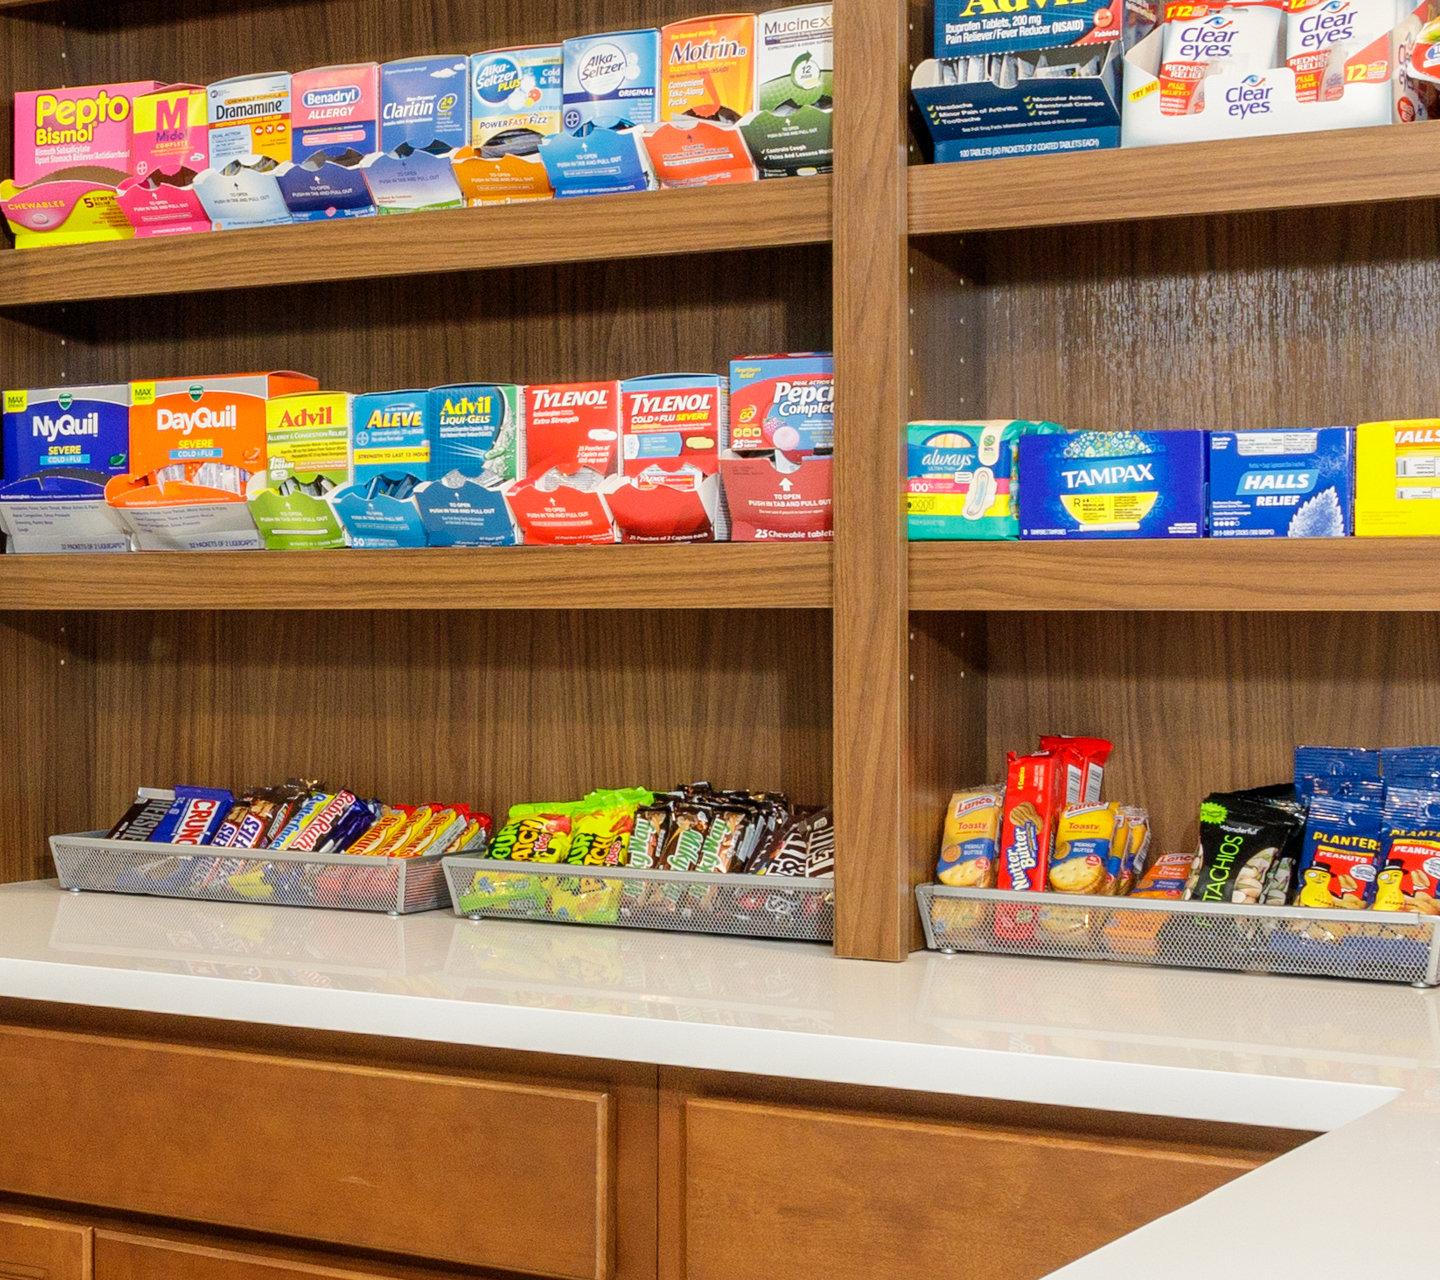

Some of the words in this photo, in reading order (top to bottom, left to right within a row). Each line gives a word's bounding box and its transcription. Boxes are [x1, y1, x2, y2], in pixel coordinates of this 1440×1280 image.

[1012, 16, 1027, 26] 200
[1301, 9, 1357, 35] Clear
[1180, 26, 1239, 45] Clear
[1301, 28, 1353, 50] eyes
[670, 40, 739, 64] Motrin
[1179, 41, 1230, 62] eyes
[480, 63, 511, 76] Alka-
[582, 60, 626, 79] Seltzer
[584, 54, 617, 71] Alka-
[477, 71, 517, 91] Seltzer
[498, 80, 522, 91] PLUS
[307, 89, 355, 105] Benadryl
[619, 88, 654, 98] ORIGINAL
[35, 90, 129, 126] Pepto
[216, 99, 282, 120] Dramamine
[308, 106, 354, 120] ALLERGY
[383, 100, 434, 119] Claritin
[35, 121, 93, 145] Bismol
[134, 388, 152, 397] MAX
[533, 389, 608, 410] TYLENOL
[440, 396, 491, 415] Advil
[631, 393, 712, 414] TYLENOL
[33, 413, 98, 438] NyQuil
[157, 405, 237, 431] DayQuil
[278, 407, 332, 427] Advil
[366, 410, 422, 429] ALEVE
[441, 415, 490, 425] LIQUI-GELS
[676, 412, 708, 421] SEVERE
[48, 445, 81, 455] SEVERE
[178, 439, 213, 448] SEVERE
[922, 450, 973, 466] always
[1062, 463, 1154, 488] TAMPAX
[1244, 473, 1309, 489] HALLS
[1256, 495, 1300, 507] RELIEF
[958, 821, 988, 832] Toasty
[1021, 828, 1040, 872] Butter
[1009, 846, 1031, 891] Nutter
